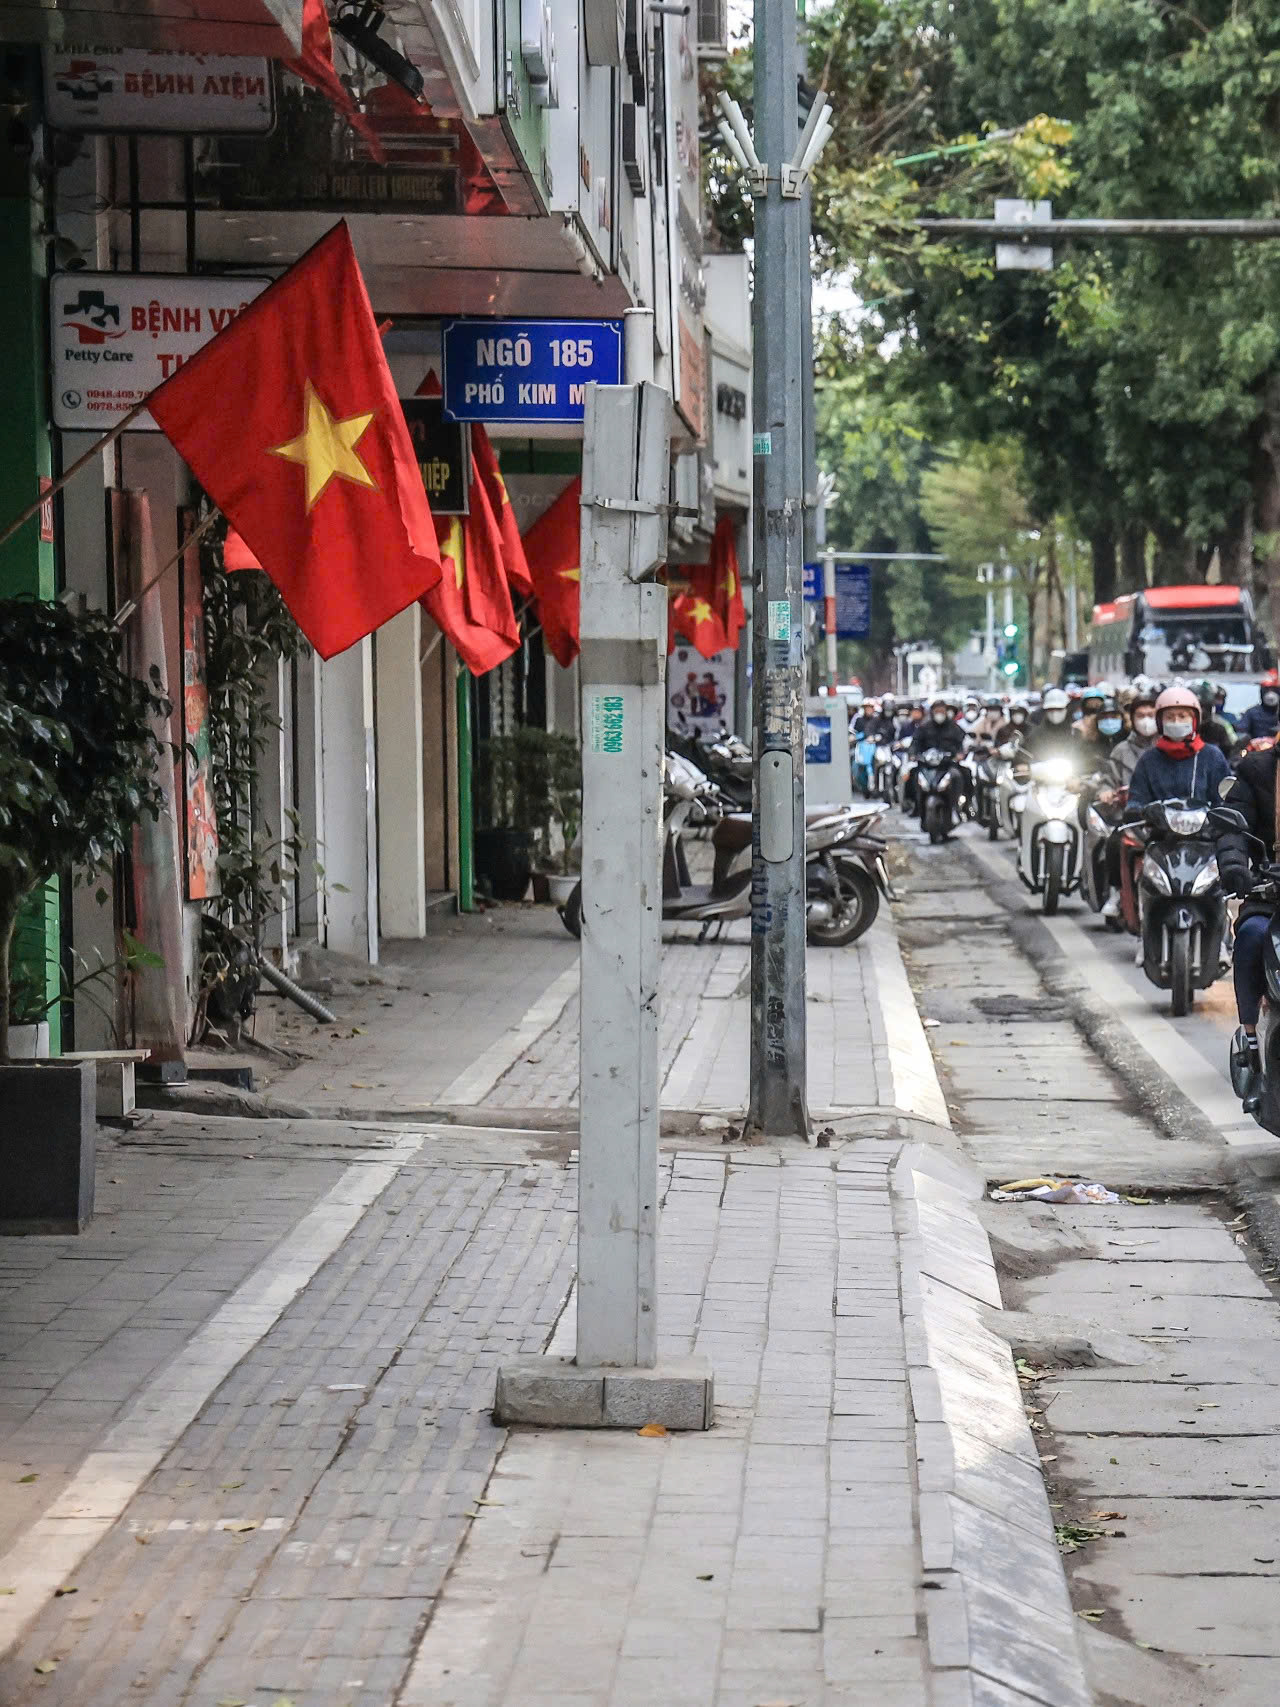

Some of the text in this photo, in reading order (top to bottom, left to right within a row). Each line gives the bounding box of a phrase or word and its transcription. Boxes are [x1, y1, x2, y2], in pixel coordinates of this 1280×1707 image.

[131, 300, 250, 339] BỆNH VI
[65, 349, 134, 364] Petty Care
[476, 333, 594, 367] NGÕ 185
[465, 373, 505, 405] PHỐ
[518, 383, 556, 405] KIM
